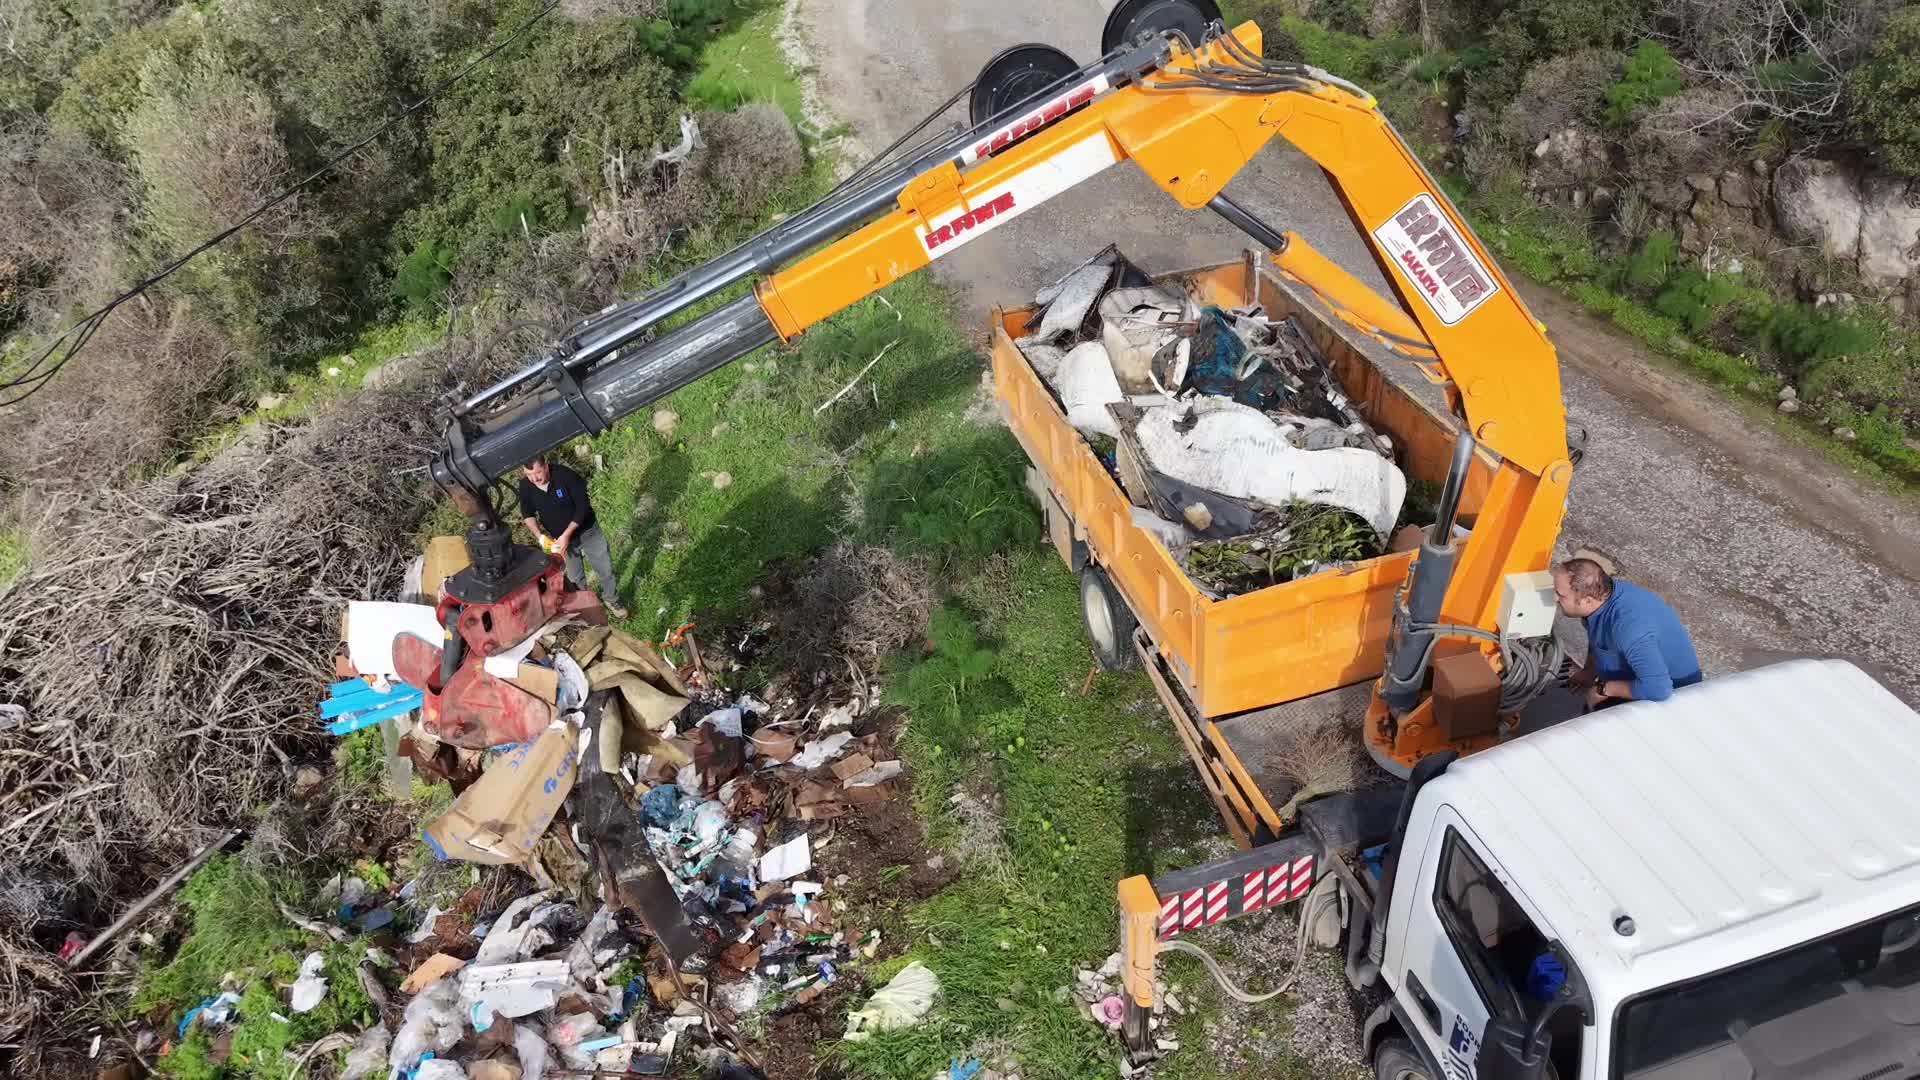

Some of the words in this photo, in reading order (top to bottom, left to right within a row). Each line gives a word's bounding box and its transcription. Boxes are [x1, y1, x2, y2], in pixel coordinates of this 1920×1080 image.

[1395, 199, 1491, 309] ERPOWER
[1401, 249, 1440, 298] SAKARYA
[1456, 1013, 1481, 1051] BODR
